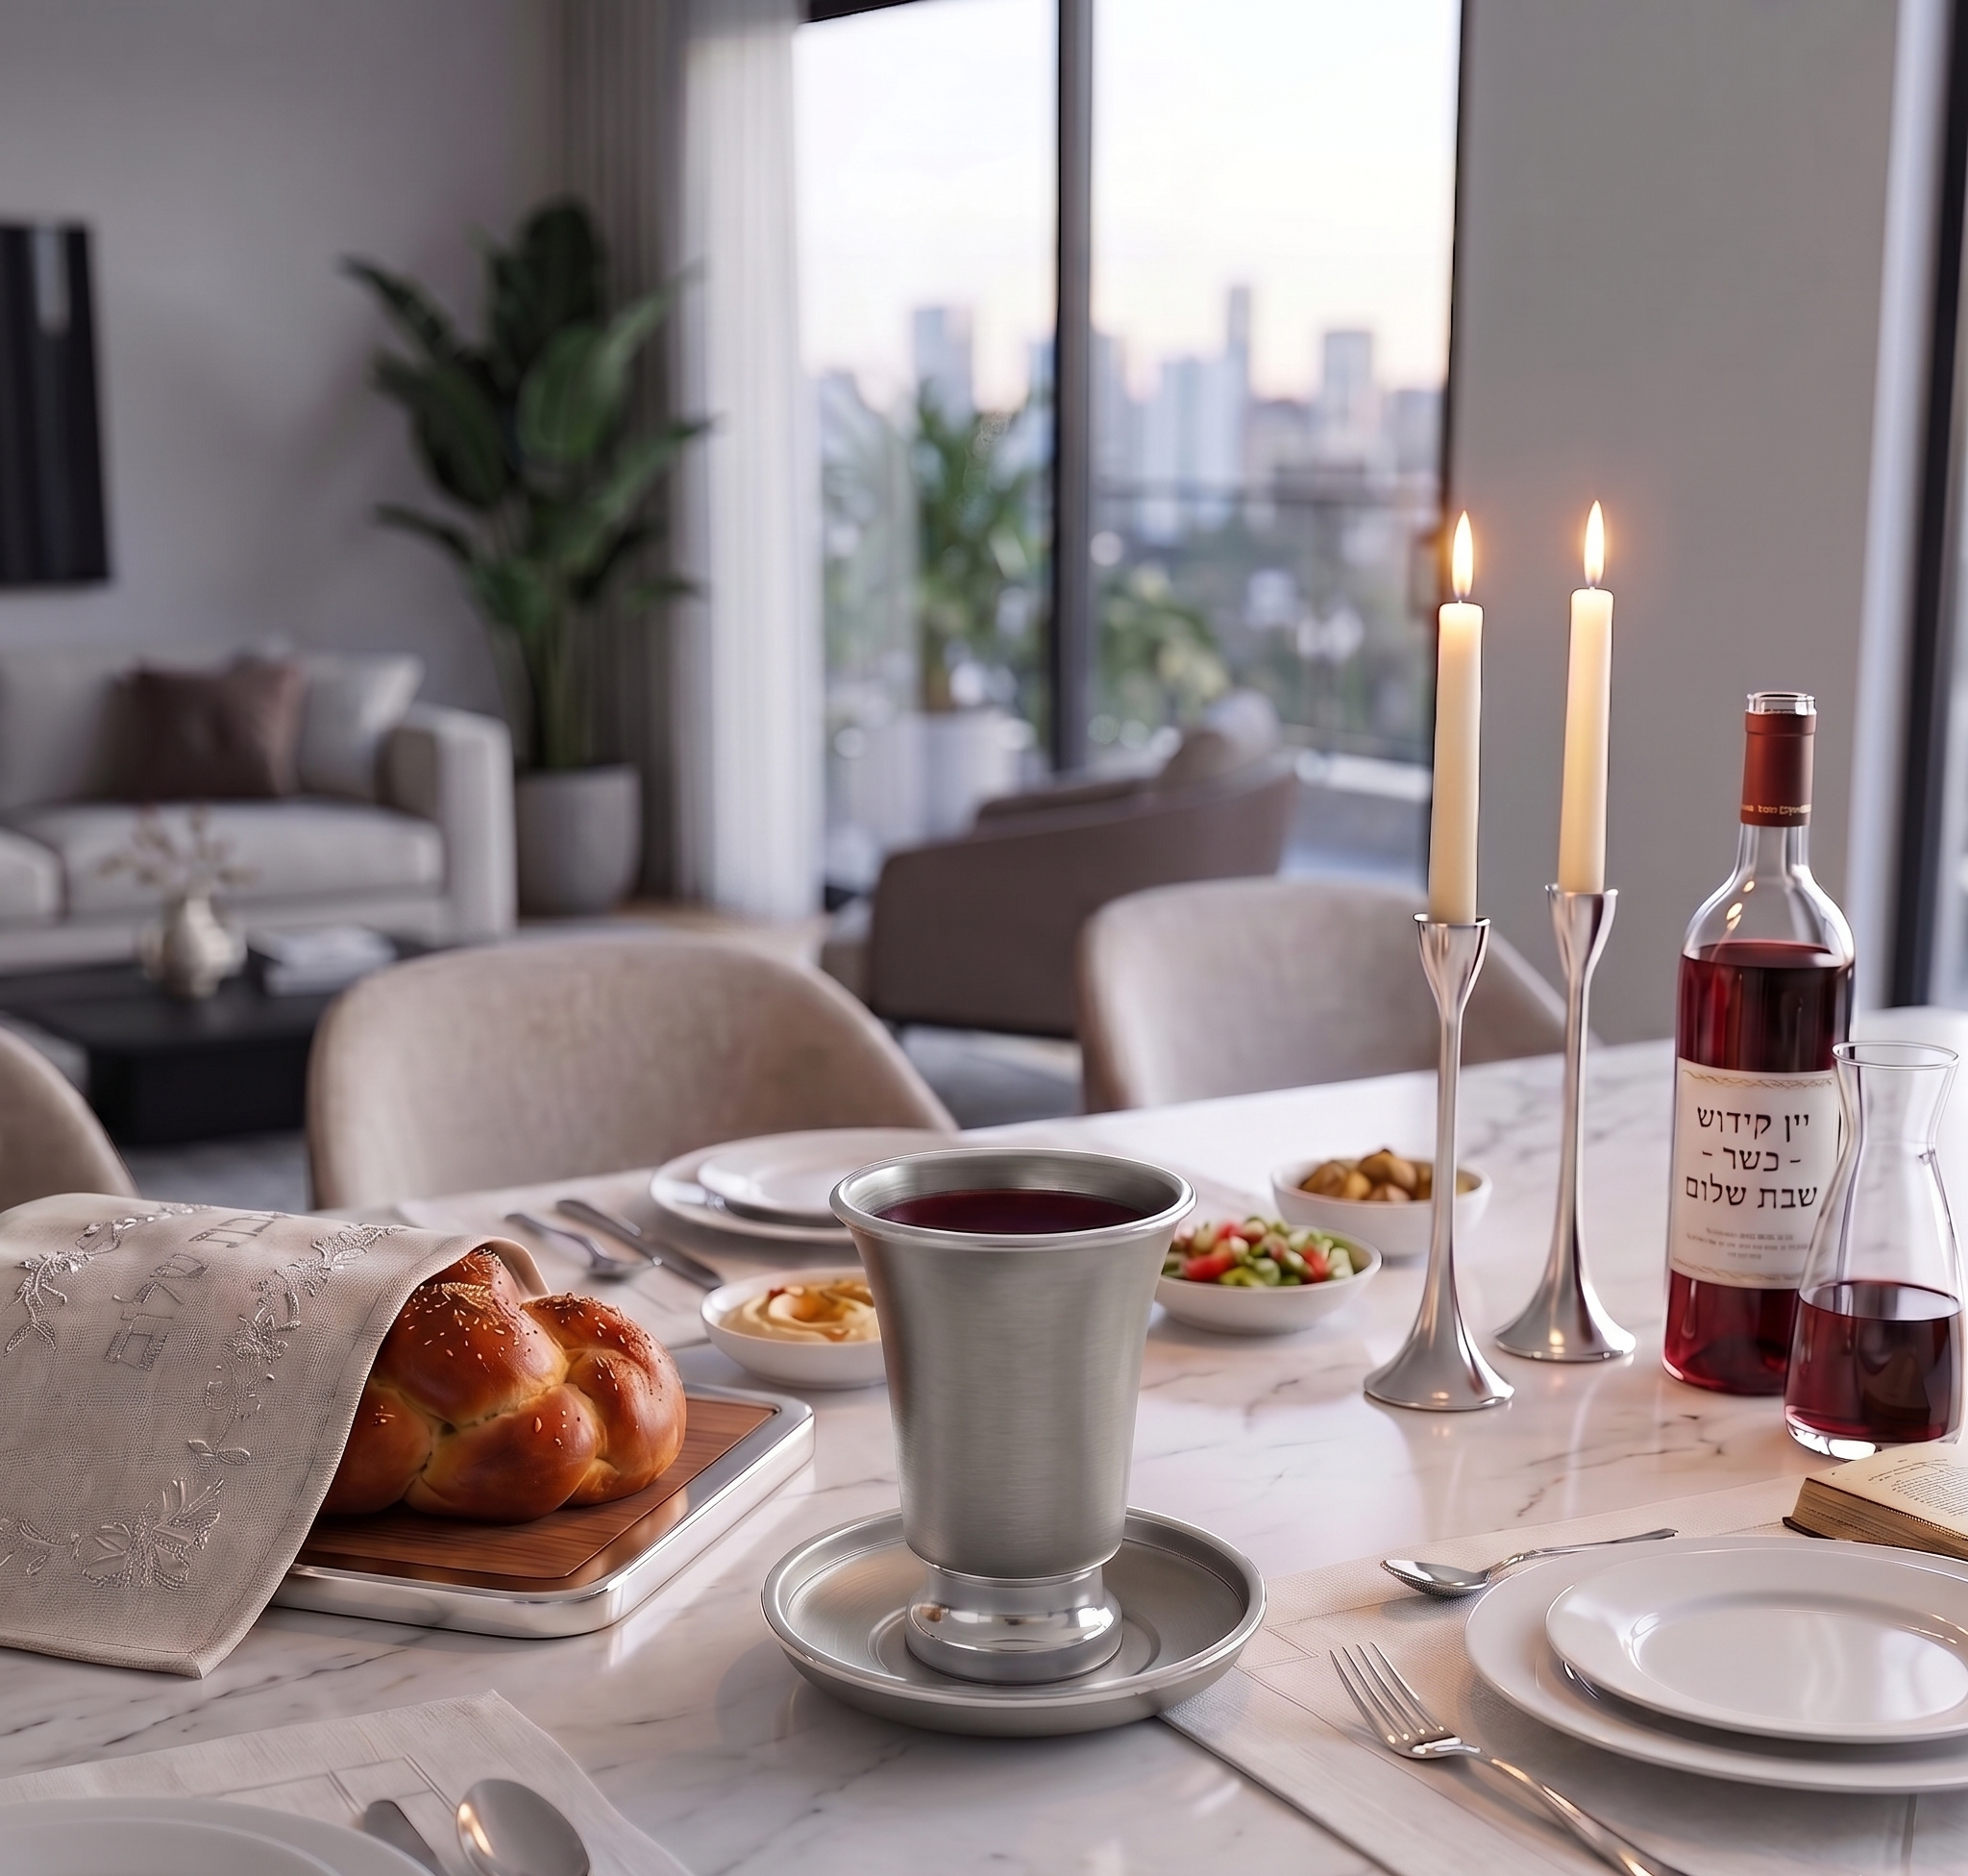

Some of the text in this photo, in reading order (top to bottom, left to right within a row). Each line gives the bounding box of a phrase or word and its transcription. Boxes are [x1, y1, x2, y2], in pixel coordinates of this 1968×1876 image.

[1696, 1106, 1809, 1143] יין קידוש
[1723, 1147, 1779, 1172] כשר
[1686, 1172, 1817, 1209] שבת שלום
